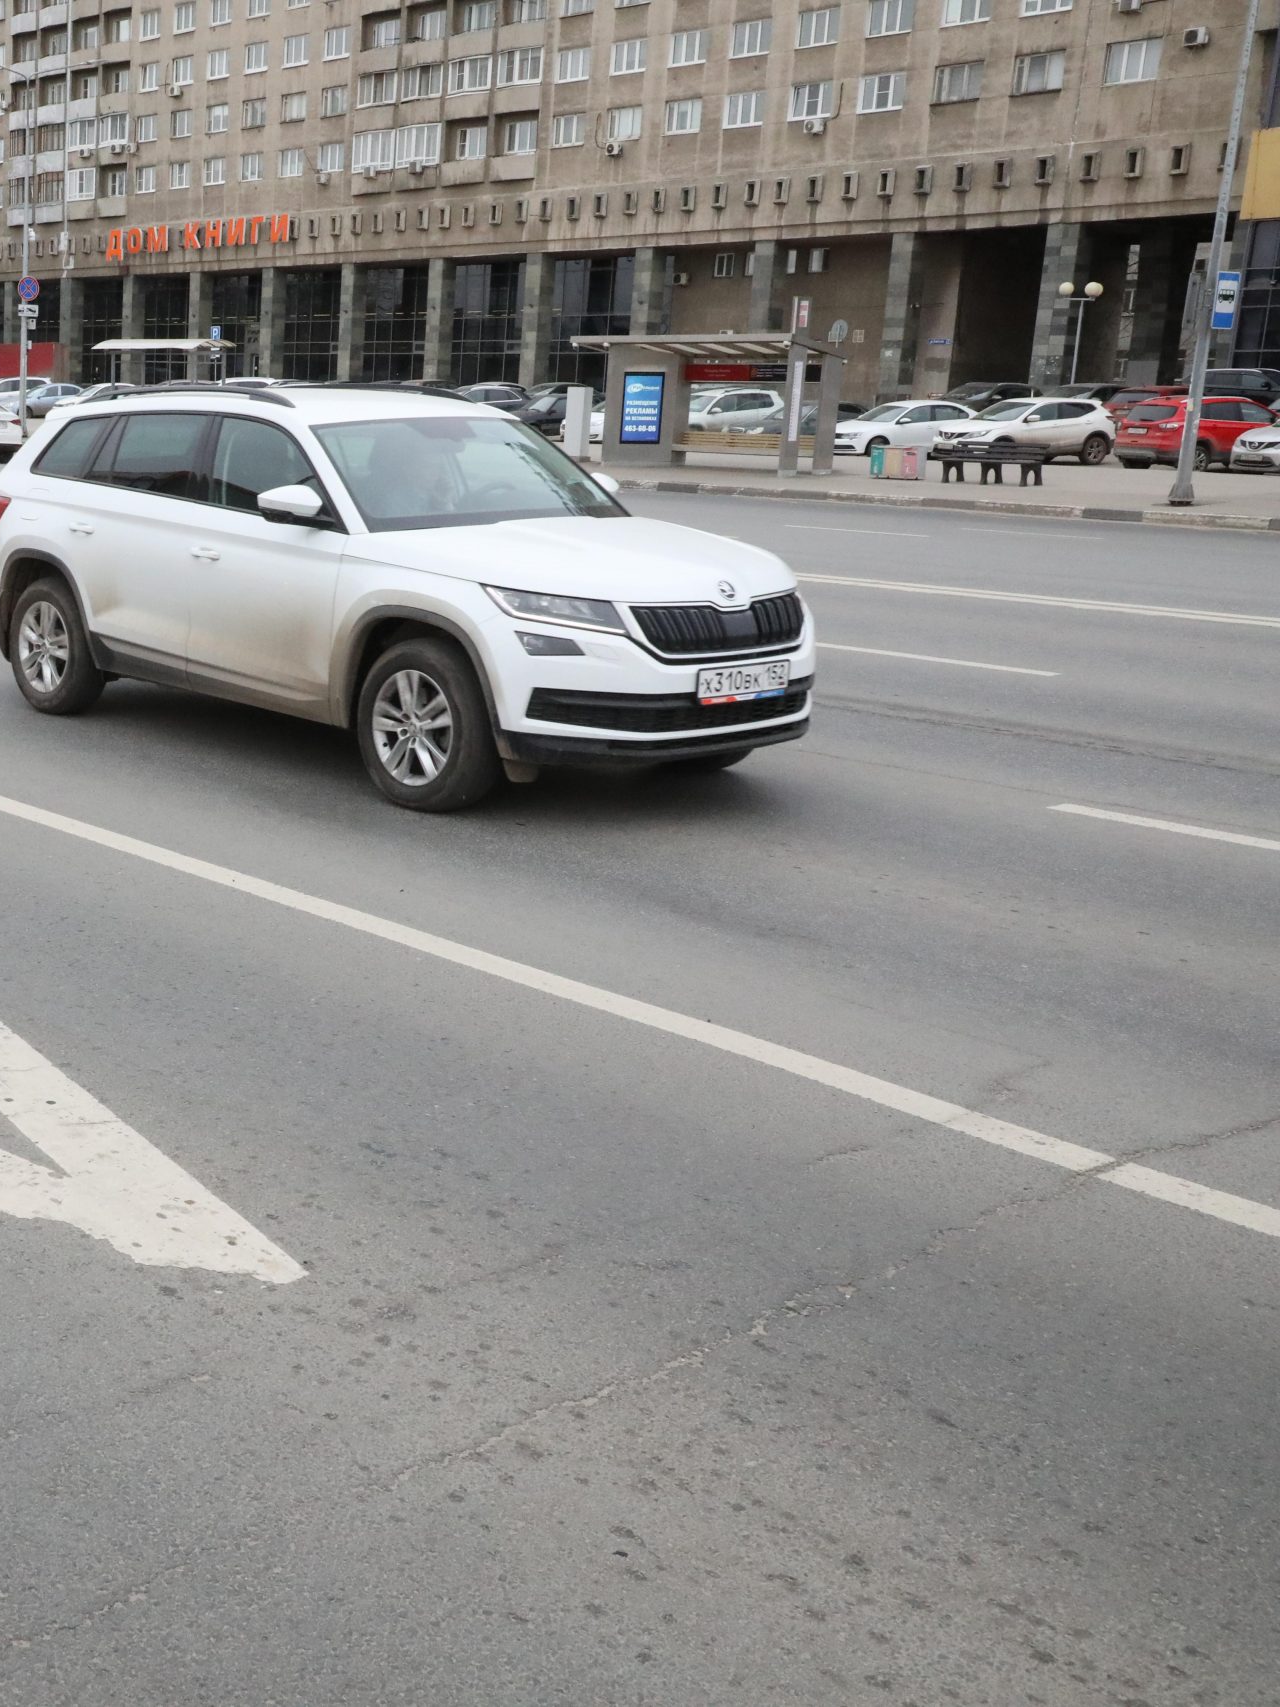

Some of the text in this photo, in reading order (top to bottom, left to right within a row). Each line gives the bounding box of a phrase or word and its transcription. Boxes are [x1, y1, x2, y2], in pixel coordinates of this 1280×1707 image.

[106, 213, 290, 262] ДОМ КНИГИ
[765, 664, 785, 680] 152
